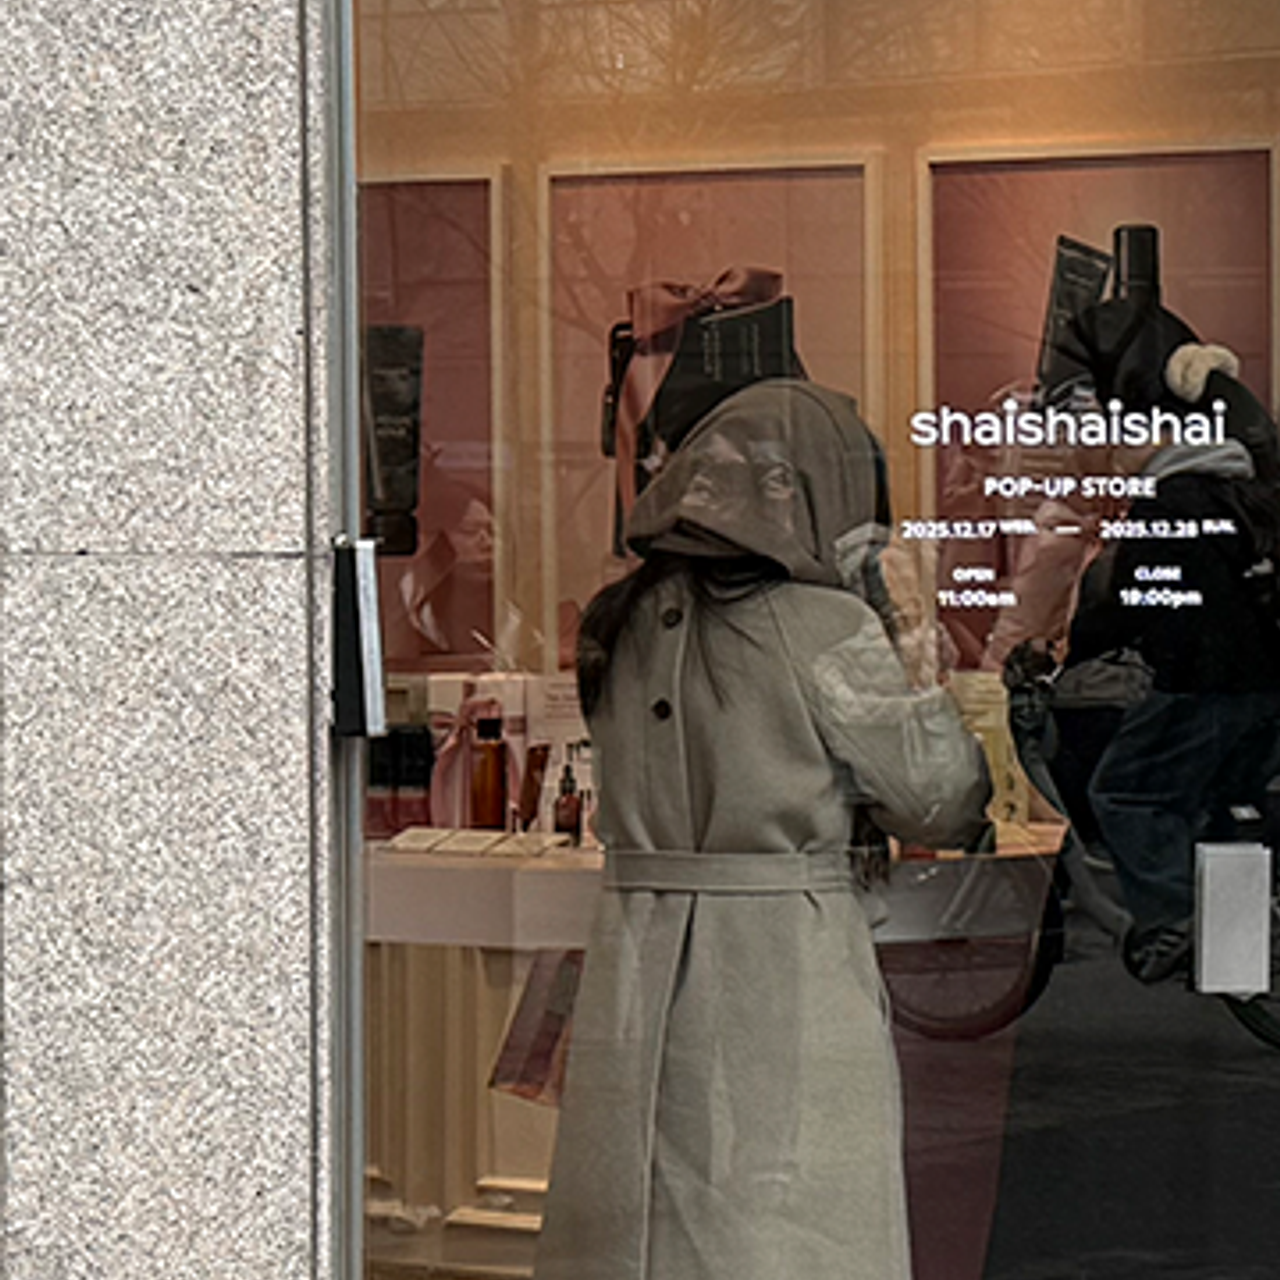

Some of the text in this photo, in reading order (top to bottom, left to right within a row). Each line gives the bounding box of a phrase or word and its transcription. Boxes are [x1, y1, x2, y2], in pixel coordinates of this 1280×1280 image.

[910, 398, 1227, 447] shaishaishai
[985, 476, 1157, 500] POP-UP STORE
[938, 588, 1018, 608] 11:00am
